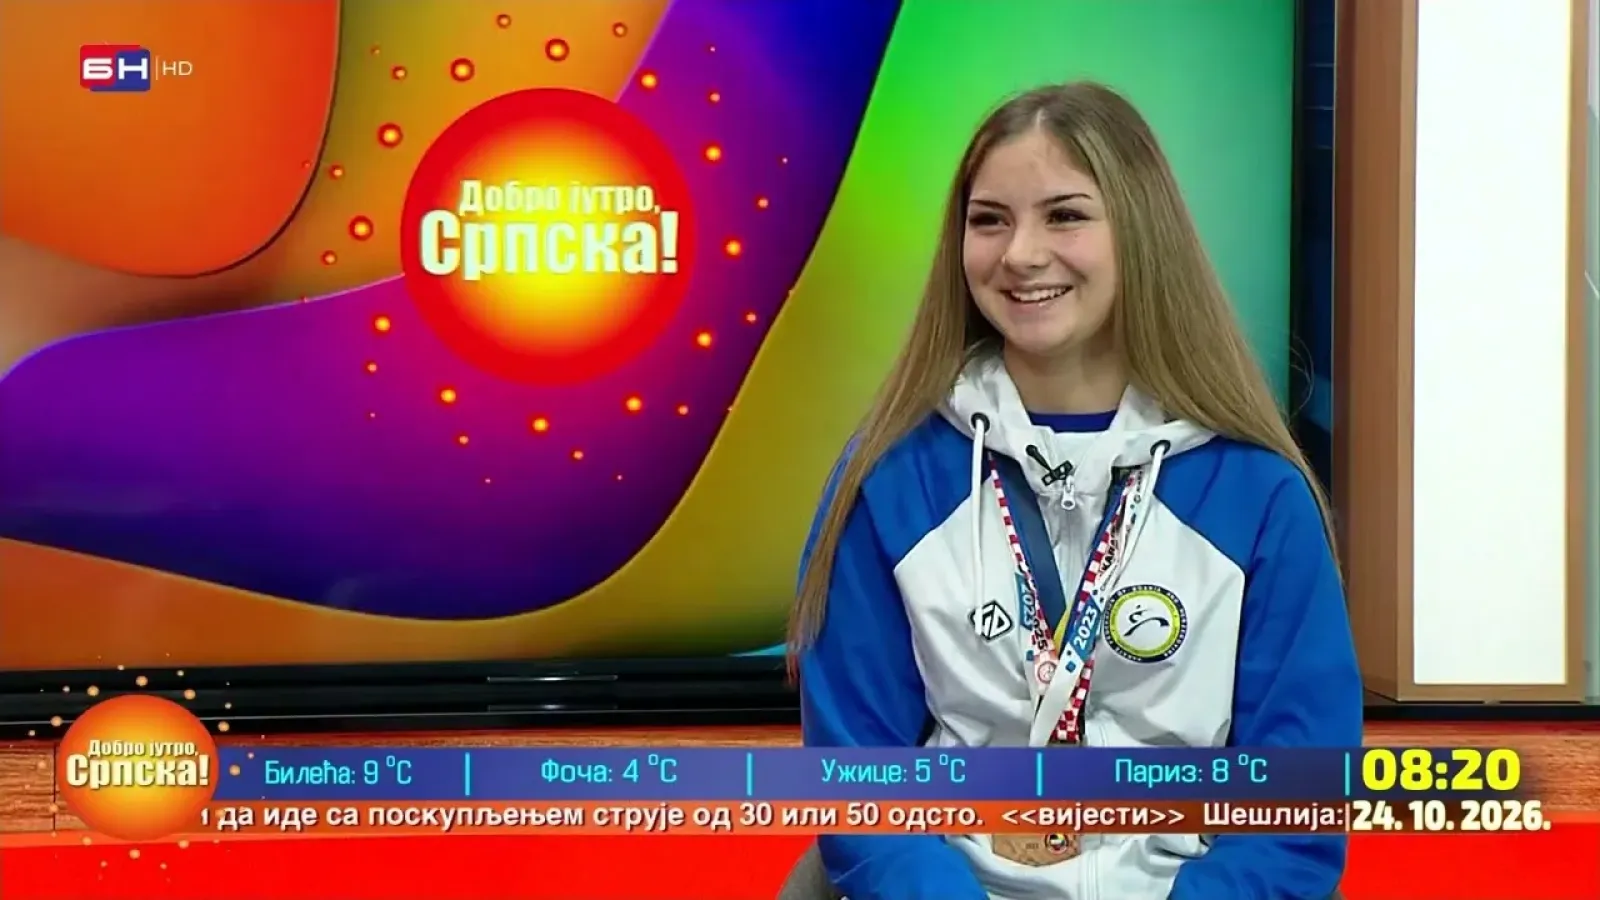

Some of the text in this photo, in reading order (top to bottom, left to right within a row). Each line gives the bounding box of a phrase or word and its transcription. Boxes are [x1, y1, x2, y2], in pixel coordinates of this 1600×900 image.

[459, 180, 661, 216] Добро јутро,
[420, 209, 679, 281] Српска!
[1073, 605, 1098, 651] 2023
